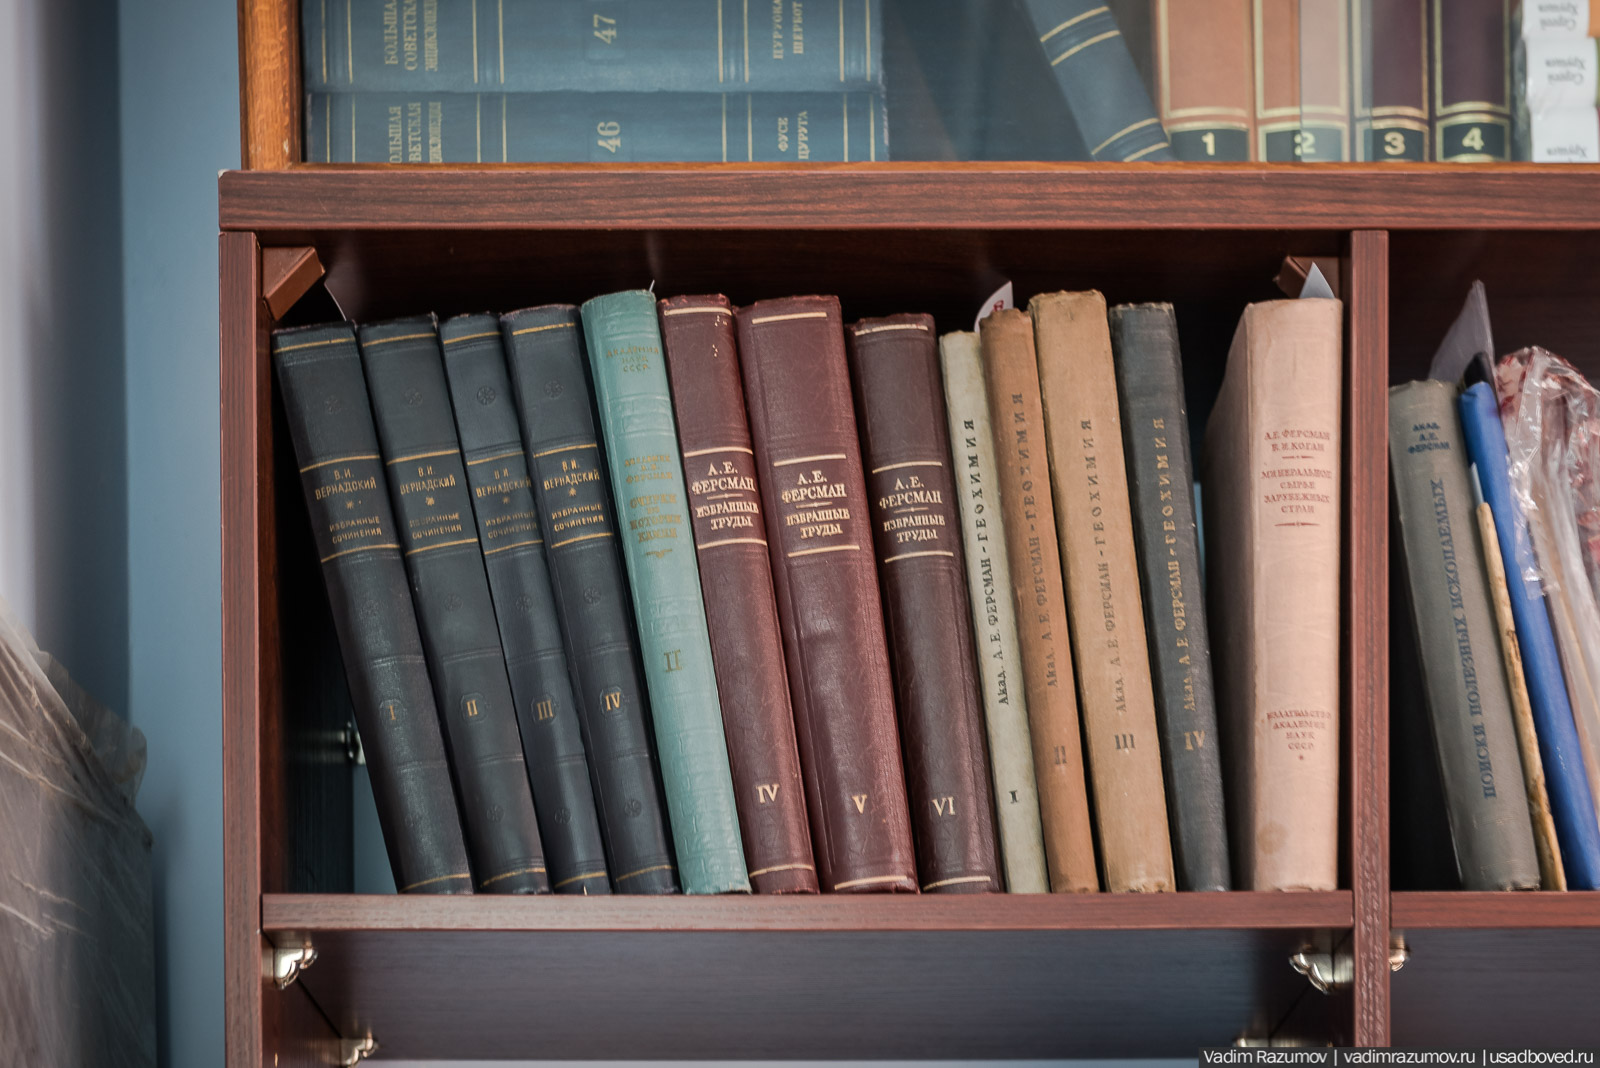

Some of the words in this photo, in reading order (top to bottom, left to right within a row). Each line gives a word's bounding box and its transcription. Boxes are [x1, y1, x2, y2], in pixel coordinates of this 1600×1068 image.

[384, 0, 398, 64] БОЛЬША
[593, 14, 617, 44] 47
[388, 106, 402, 163] ОЛЬШАЯ
[408, 102, 422, 163] ВЕТСКАЯ
[597, 121, 621, 153] 46
[1384, 131, 1406, 155] 3
[1461, 127, 1485, 151] 4
[1201, 132, 1215, 155] 1
[1294, 132, 1316, 155] 2
[1012, 393, 1036, 520] ГЕОХИМИЯ
[544, 468, 600, 491] ВЕРНАДСКИЙ
[691, 475, 756, 495] ФЕРСМАН
[964, 419, 989, 542] ГЕОХИМИЯ
[1081, 419, 1106, 546] ГЕОХИМИЯ
[1153, 417, 1176, 545] ГЕОХИМИЯ
[781, 483, 848, 504] ФЕРСМАН
[879, 490, 943, 509] ФЕРСМАН
[695, 501, 759, 518] ИЗБРАННЫЕ
[786, 508, 851, 526] ИЗБРАННЫЕ
[1280, 505, 1315, 513] СТРАН
[412, 524, 462, 539] СОЧИНЕНИЯ
[554, 514, 604, 532] СОЧИНЕНИЯ
[711, 515, 753, 531] ТРУДЫ
[800, 523, 843, 539] ТРУДЫ
[883, 514, 946, 532] ИЗБРАННЫЕ
[332, 528, 382, 544] СОЧИНЕНИЯ
[896, 529, 939, 544] ТРУДЫ
[1430, 477, 1464, 609] ИСКОПАЕМЫХ
[1029, 535, 1048, 607] ФЕРСМАН
[981, 557, 999, 627] ФЕРСМАН
[1098, 561, 1116, 632] ФЕРСМАН
[1167, 560, 1187, 631] ФЕРСМАН
[663, 650, 682, 673] II
[1453, 615, 1483, 717] ПОЛЕЗНЫХ
[466, 699, 478, 717] II
[536, 700, 554, 720] III
[604, 692, 621, 711] IV
[388, 705, 396, 720] I
[1114, 734, 1136, 750] III
[1184, 730, 1206, 750] IV
[1054, 745, 1067, 765] II
[1472, 722, 1497, 799] ПОИСКИ
[756, 783, 780, 804] IV
[852, 794, 867, 814] V
[1008, 789, 1018, 804] I
[932, 796, 956, 817] VI
